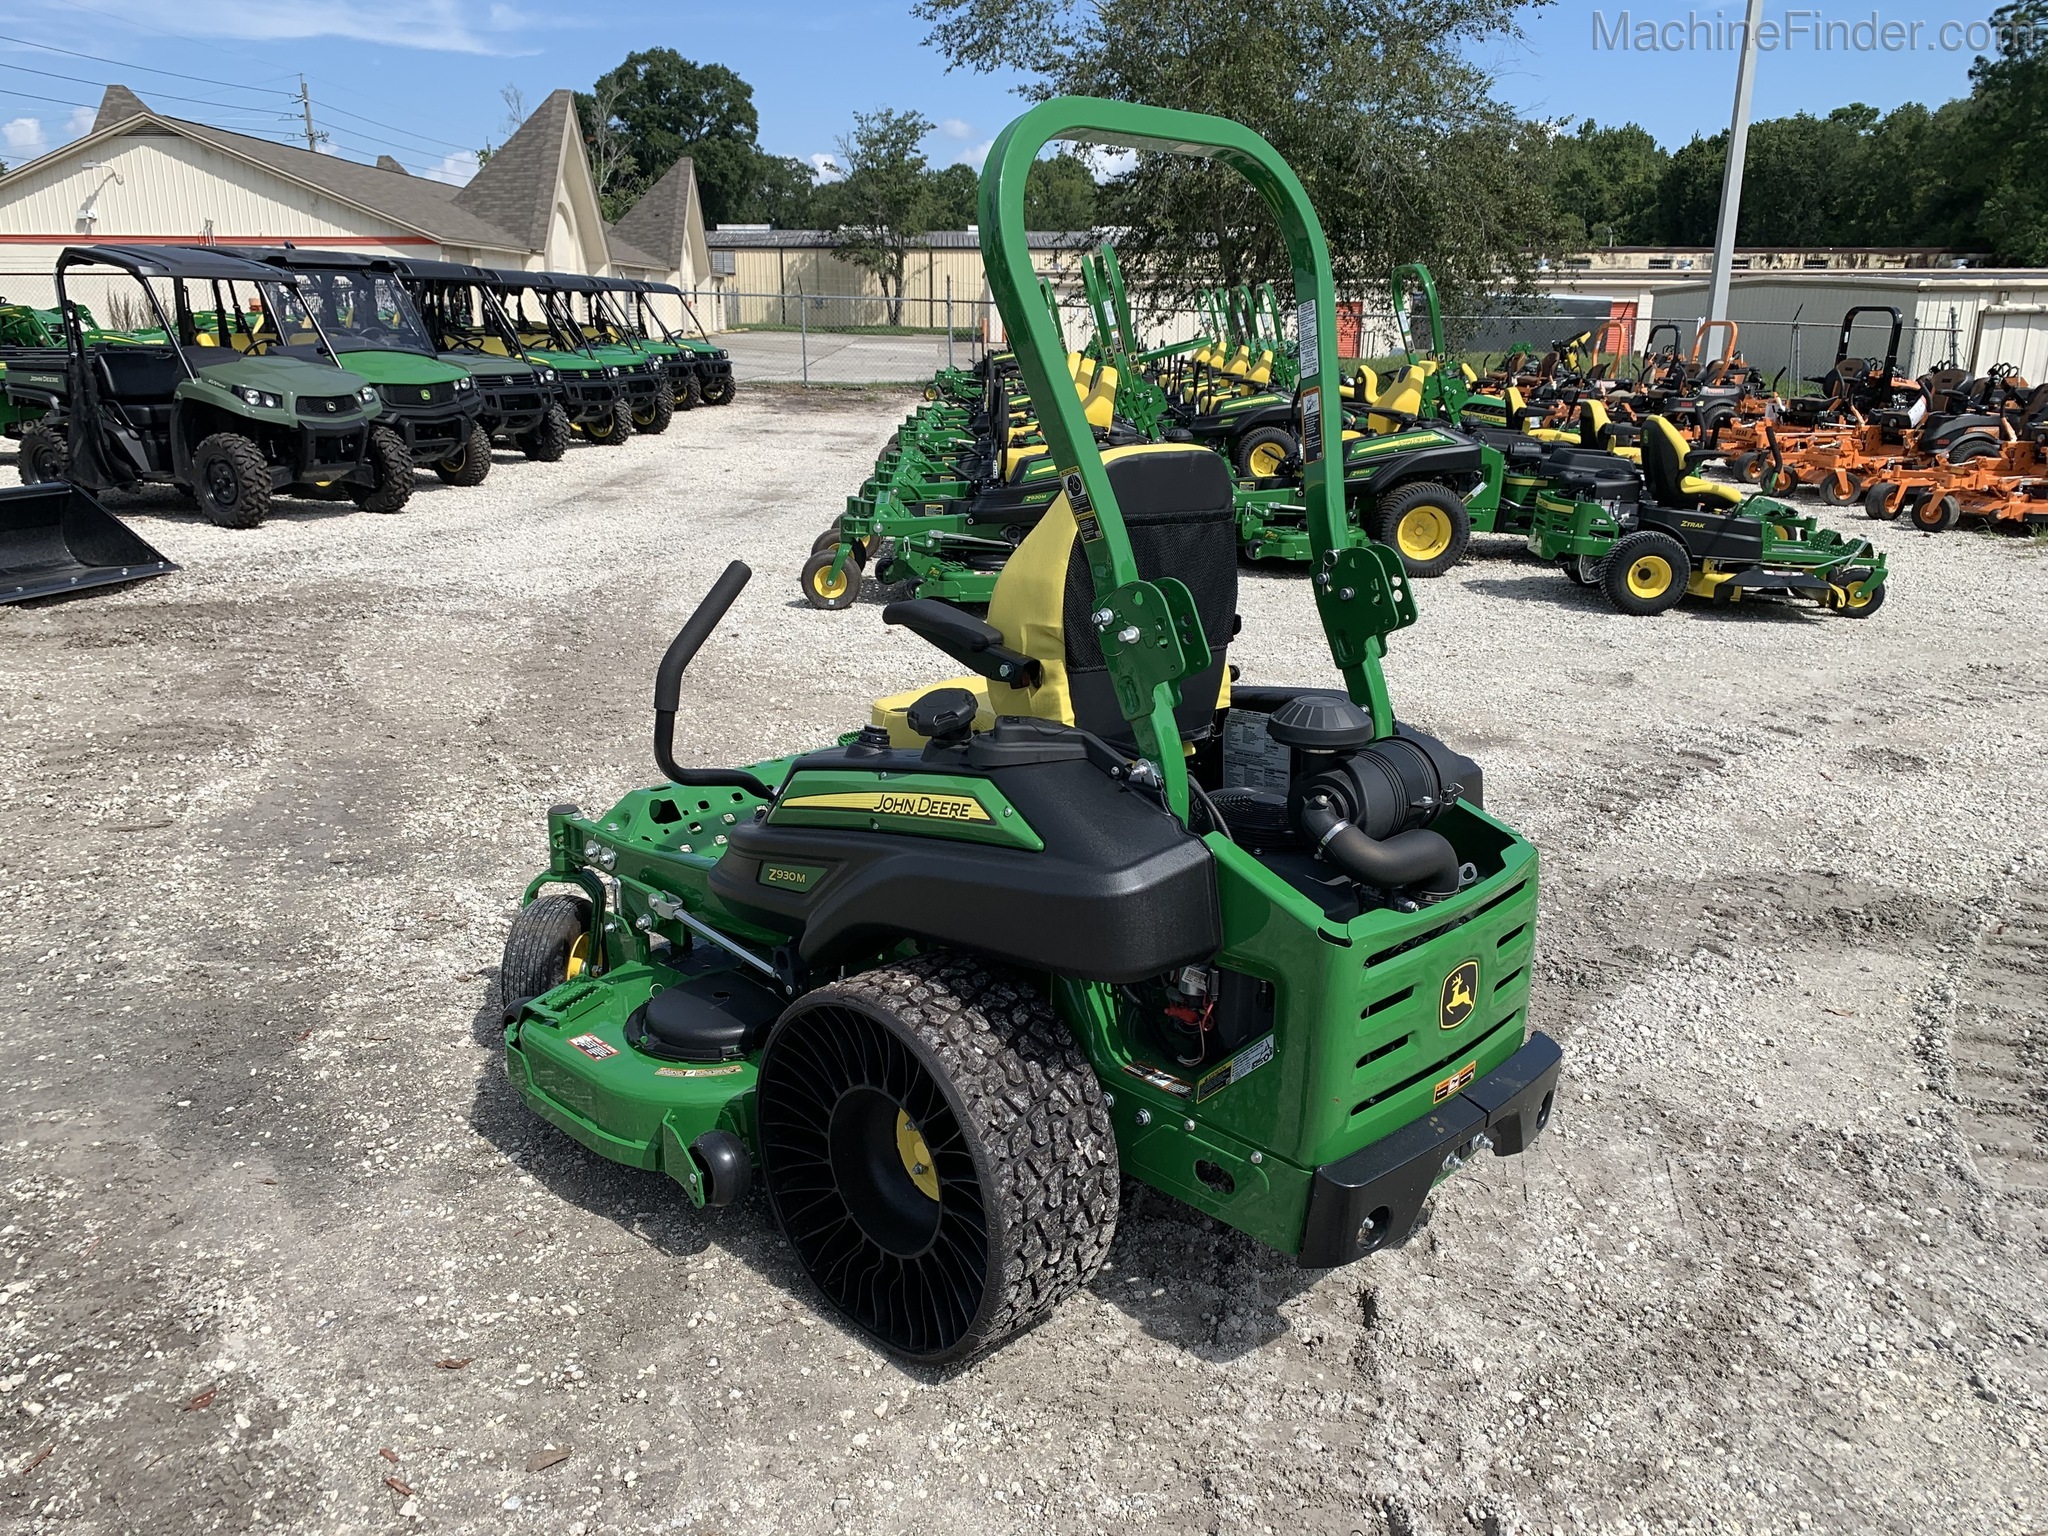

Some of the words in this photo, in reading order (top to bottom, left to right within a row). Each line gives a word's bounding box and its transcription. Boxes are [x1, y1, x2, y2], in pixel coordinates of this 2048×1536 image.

[1681, 520, 1705, 528] ZTRAK
[874, 794, 916, 813] JOHN
[918, 797, 972, 817] DEERE
[768, 868, 806, 883] Z930M
